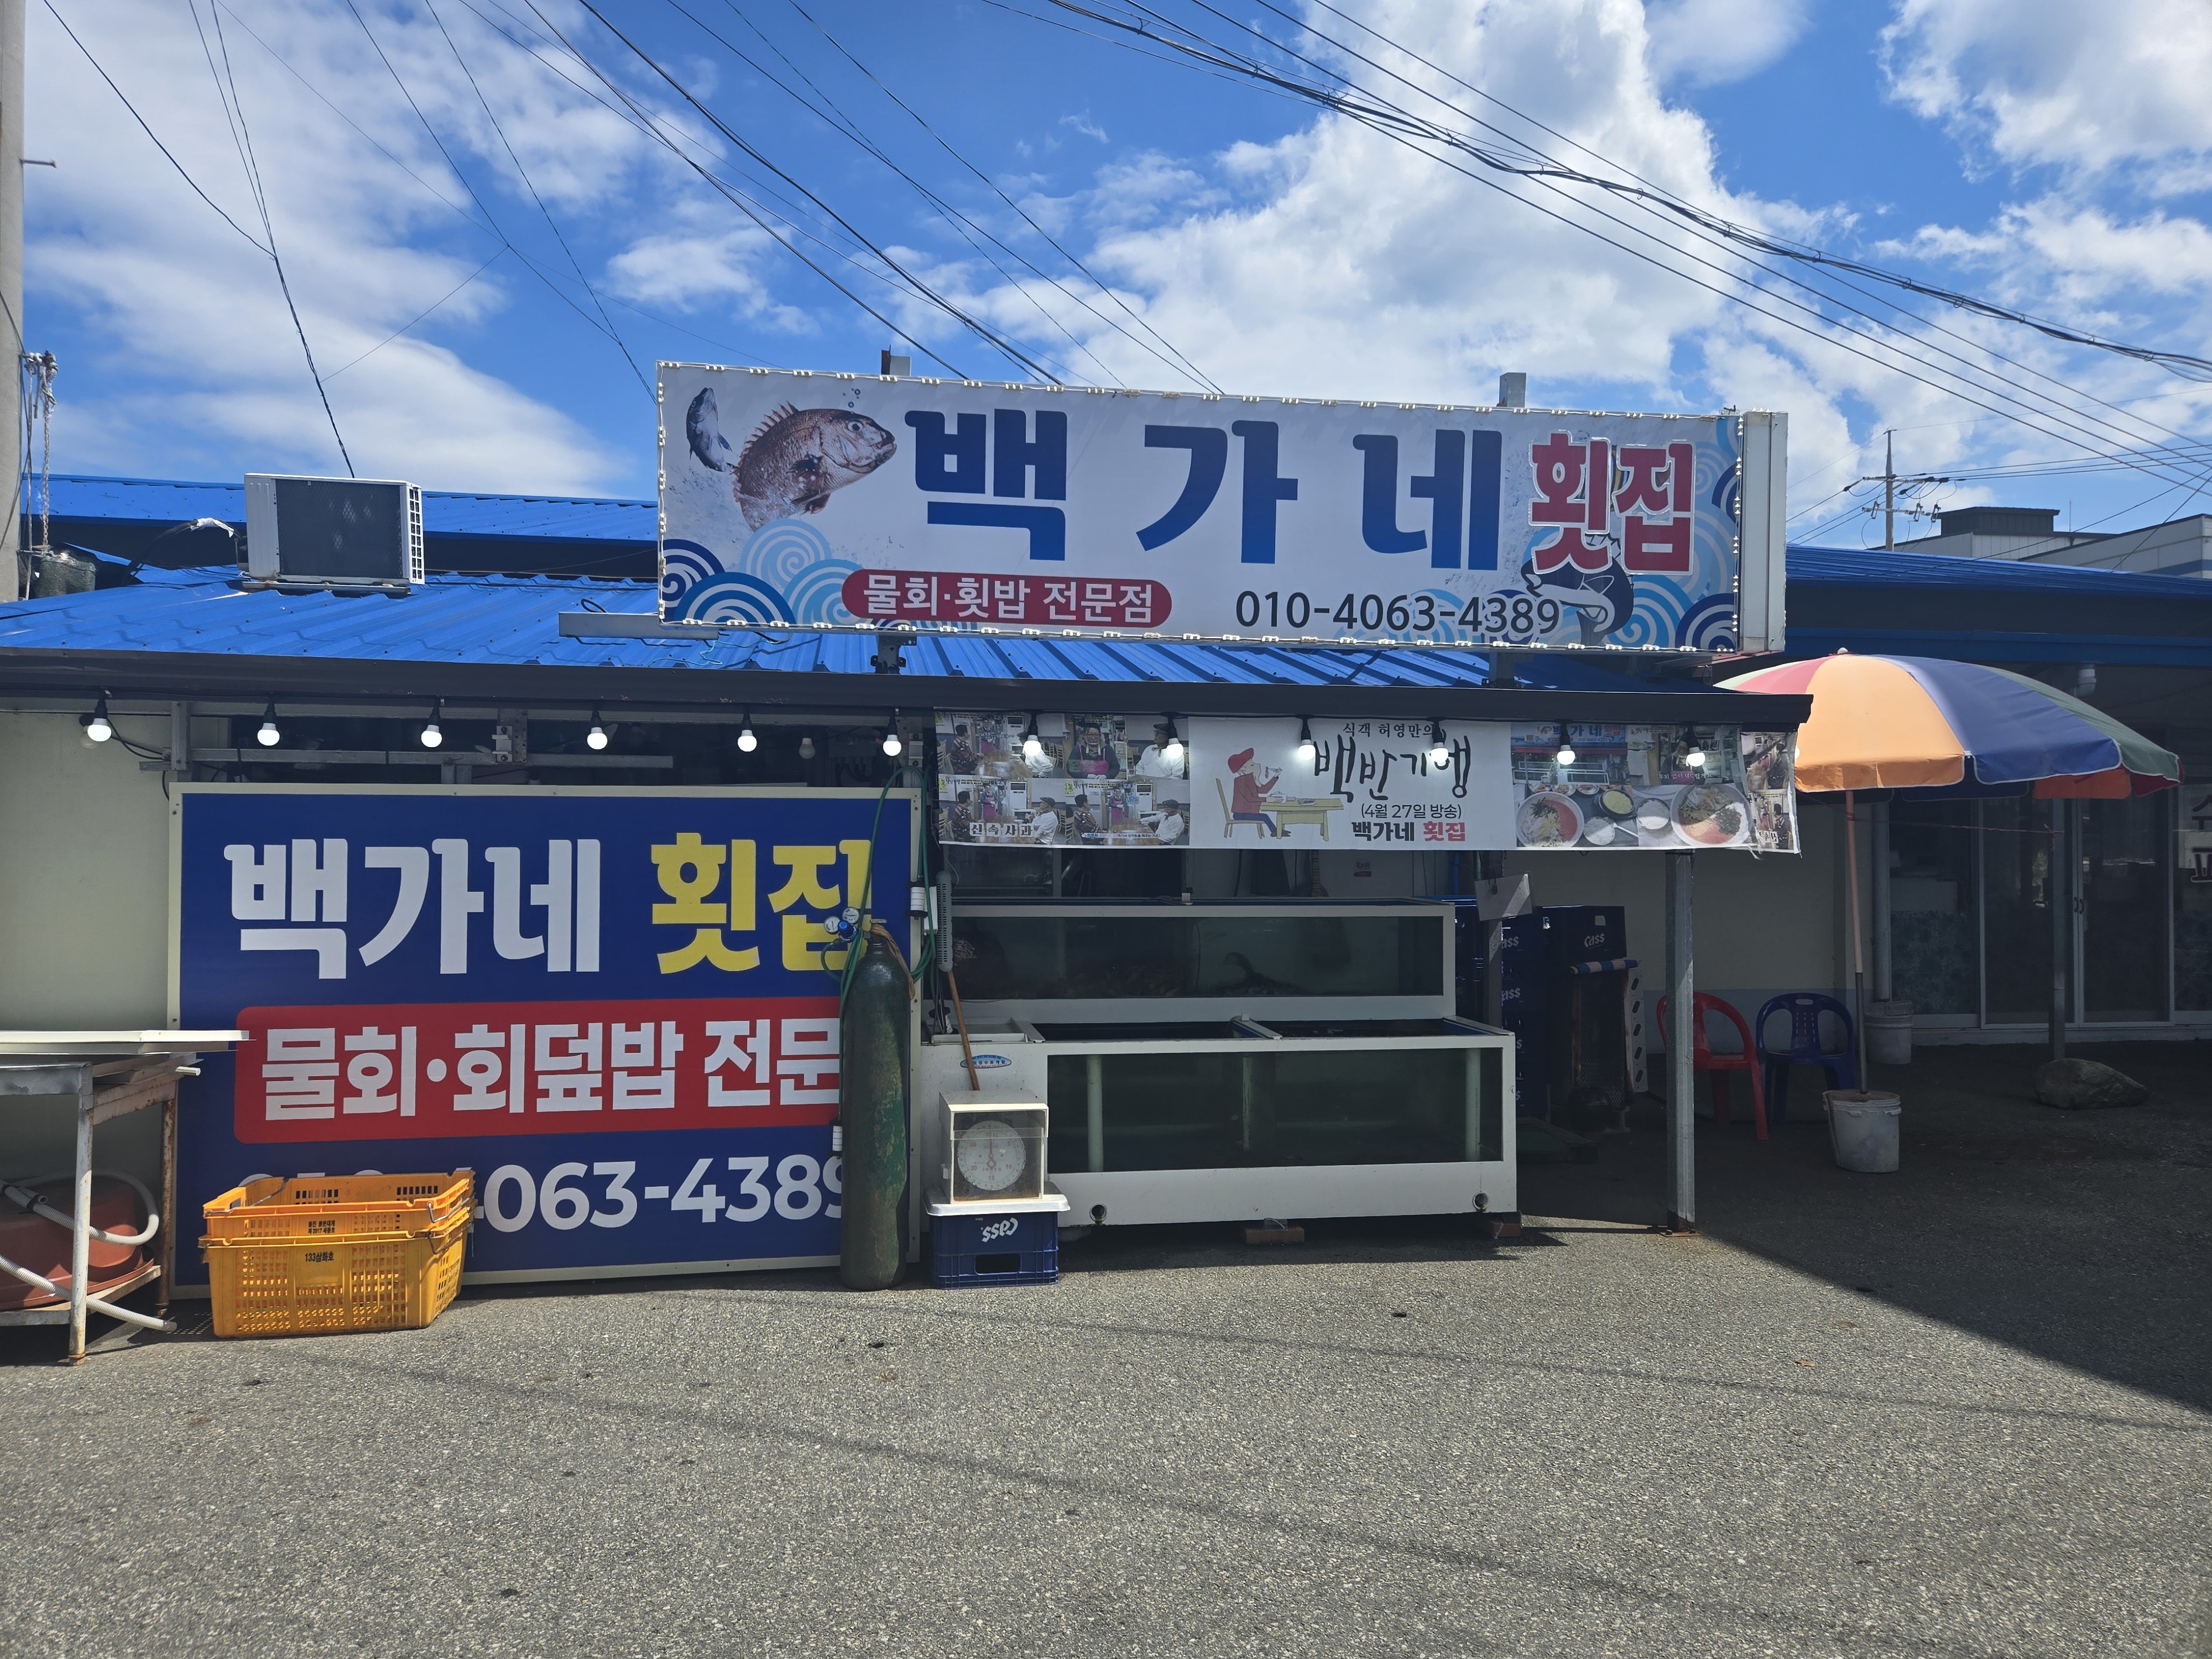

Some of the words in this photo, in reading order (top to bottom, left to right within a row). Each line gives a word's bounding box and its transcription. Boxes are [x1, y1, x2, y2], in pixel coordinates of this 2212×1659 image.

[1530, 430, 1694, 574] 횟집
[1042, 577, 1152, 623] 전문점
[1236, 591, 1561, 635] 010-4063-4389
[1343, 722, 1370, 737] 식객
[1378, 723, 1435, 738] 허영만의
[1361, 804, 1387, 818] (4월
[1392, 805, 1426, 818] 27일
[1430, 804, 1462, 818] 방송)
[1352, 821, 1415, 842] 백가네
[1423, 821, 1465, 842] 횟집
[224, 838, 601, 980] 백가네
[650, 832, 873, 974] 횟집
[1501, 936, 1520, 950] ass
[1584, 933, 1605, 948] Cass
[1501, 987, 1521, 1001] ass
